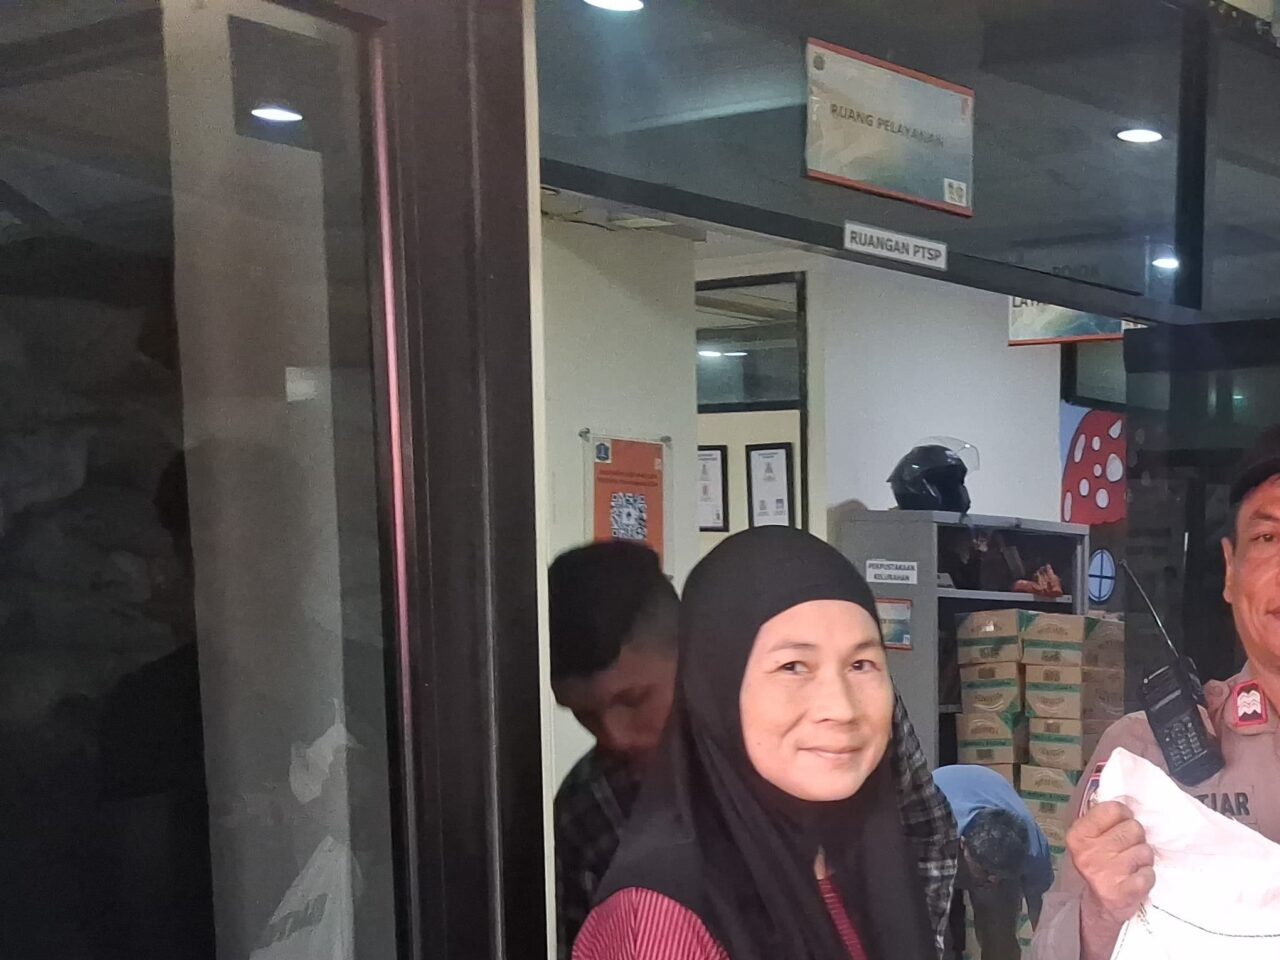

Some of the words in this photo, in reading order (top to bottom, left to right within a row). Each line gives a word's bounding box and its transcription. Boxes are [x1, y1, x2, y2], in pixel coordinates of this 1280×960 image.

[831, 103, 873, 128] RUANG
[850, 231, 909, 255] RUANGAN
[913, 243, 942, 261] PTSP
